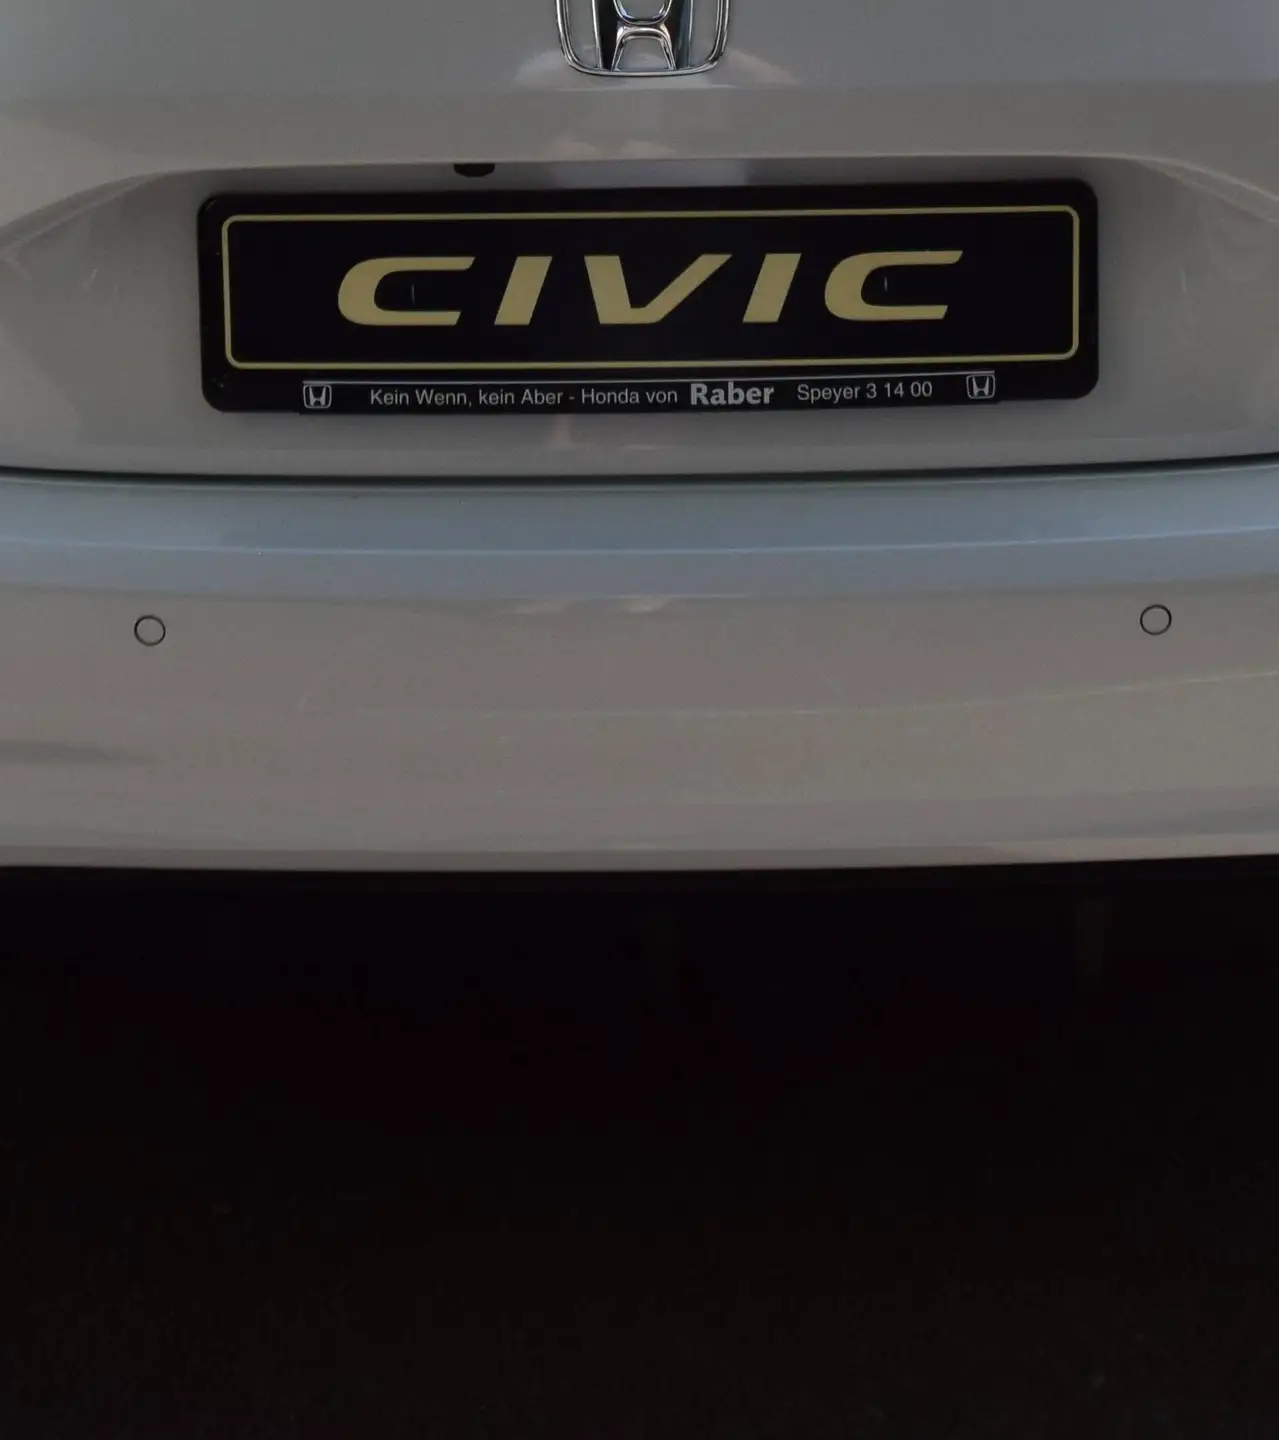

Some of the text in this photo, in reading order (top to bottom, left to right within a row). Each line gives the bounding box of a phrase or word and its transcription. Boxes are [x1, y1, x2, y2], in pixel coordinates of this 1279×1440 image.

[337, 250, 963, 326] CIVIC
[370, 389, 410, 406] Kein
[415, 389, 472, 408] Wenn,
[478, 388, 515, 406] kein
[520, 388, 564, 406] Aber
[581, 387, 640, 405] Honda
[645, 390, 678, 404] von
[690, 381, 775, 406] Raber
[797, 383, 860, 403] Speyer
[866, 383, 877, 399] 3
[883, 382, 904, 398] 14
[910, 380, 933, 397] 00
